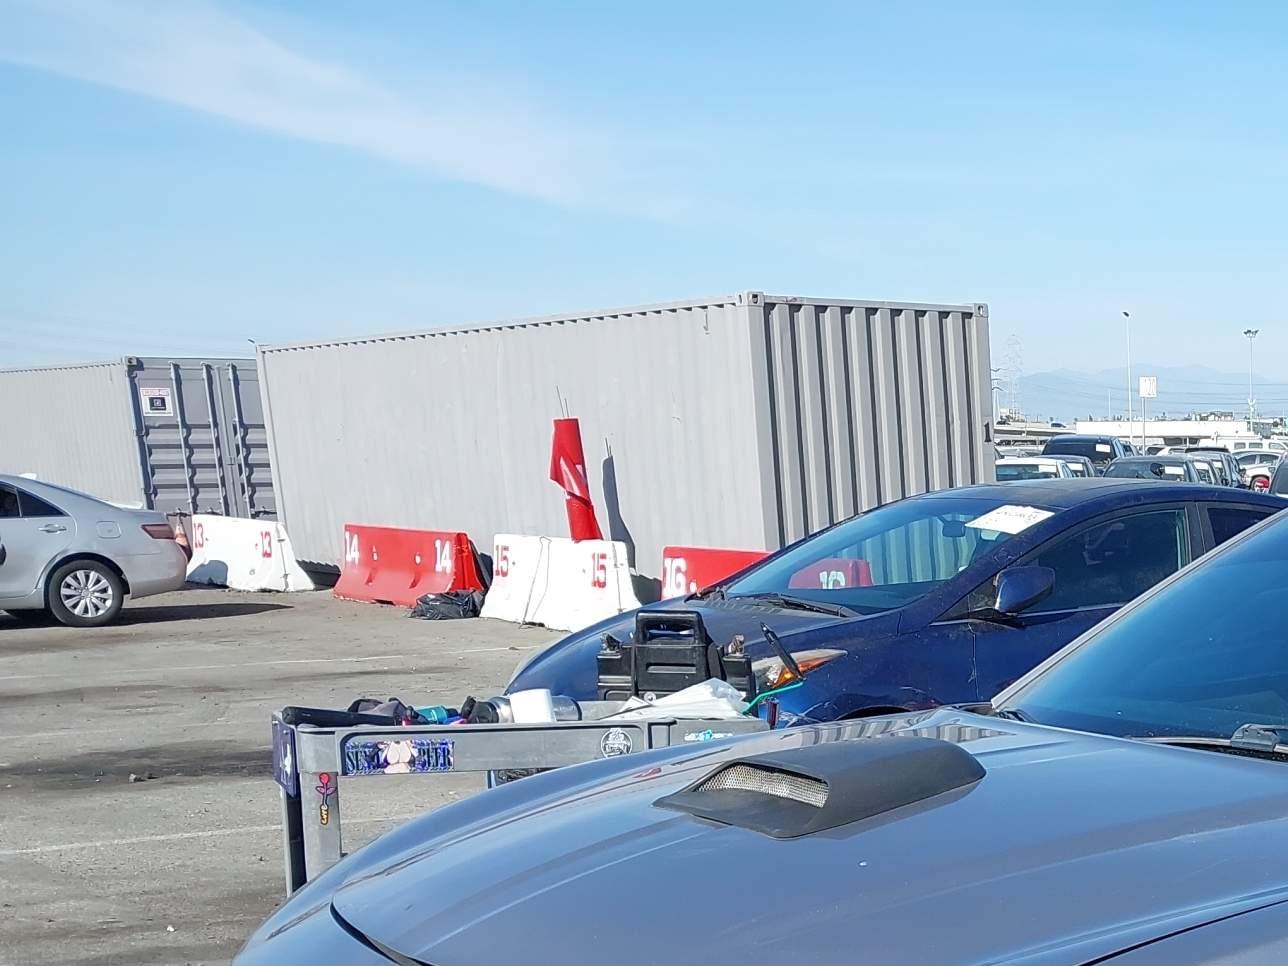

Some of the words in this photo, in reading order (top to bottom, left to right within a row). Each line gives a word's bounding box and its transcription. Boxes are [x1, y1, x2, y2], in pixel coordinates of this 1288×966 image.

[193, 523, 204, 548] 13
[260, 531, 272, 558] 13
[345, 531, 359, 565] 14
[434, 539, 452, 574] 14
[495, 544, 509, 577] 15
[592, 552, 607, 588] 15
[663, 557, 687, 598] 16
